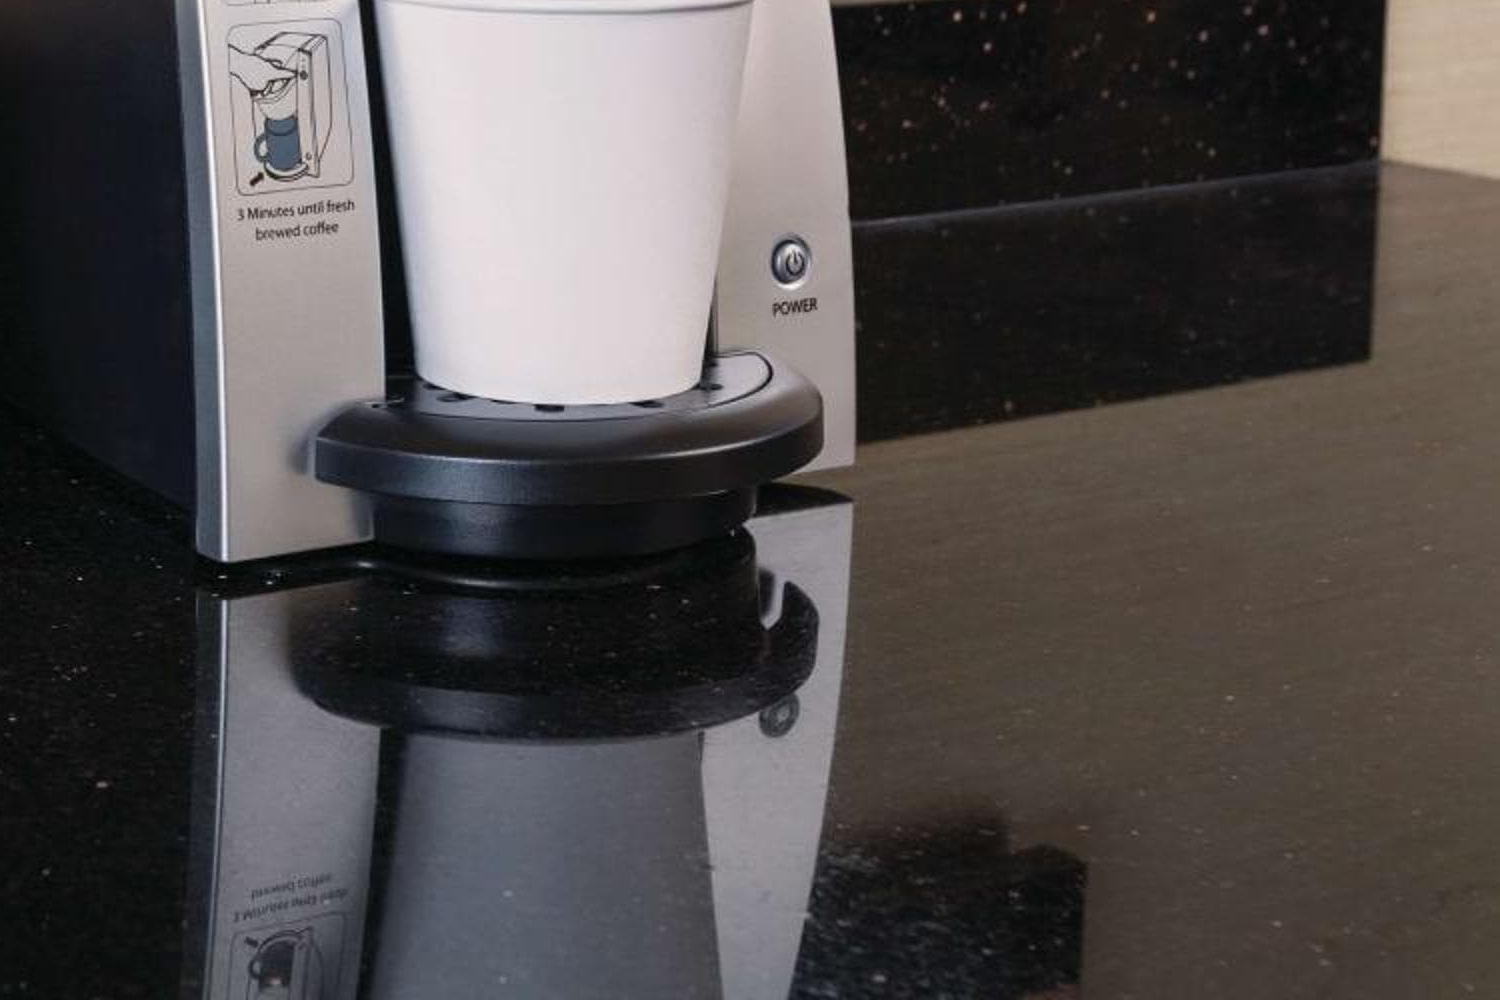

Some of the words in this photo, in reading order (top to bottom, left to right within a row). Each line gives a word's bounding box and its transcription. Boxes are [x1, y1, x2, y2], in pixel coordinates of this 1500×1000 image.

[236, 207, 245, 221] 3
[247, 206, 295, 220] Minutes
[297, 200, 325, 215] until
[326, 198, 356, 214] fresh
[255, 225, 301, 241] brewed
[302, 220, 340, 237] coffee
[772, 297, 818, 318] POWER
